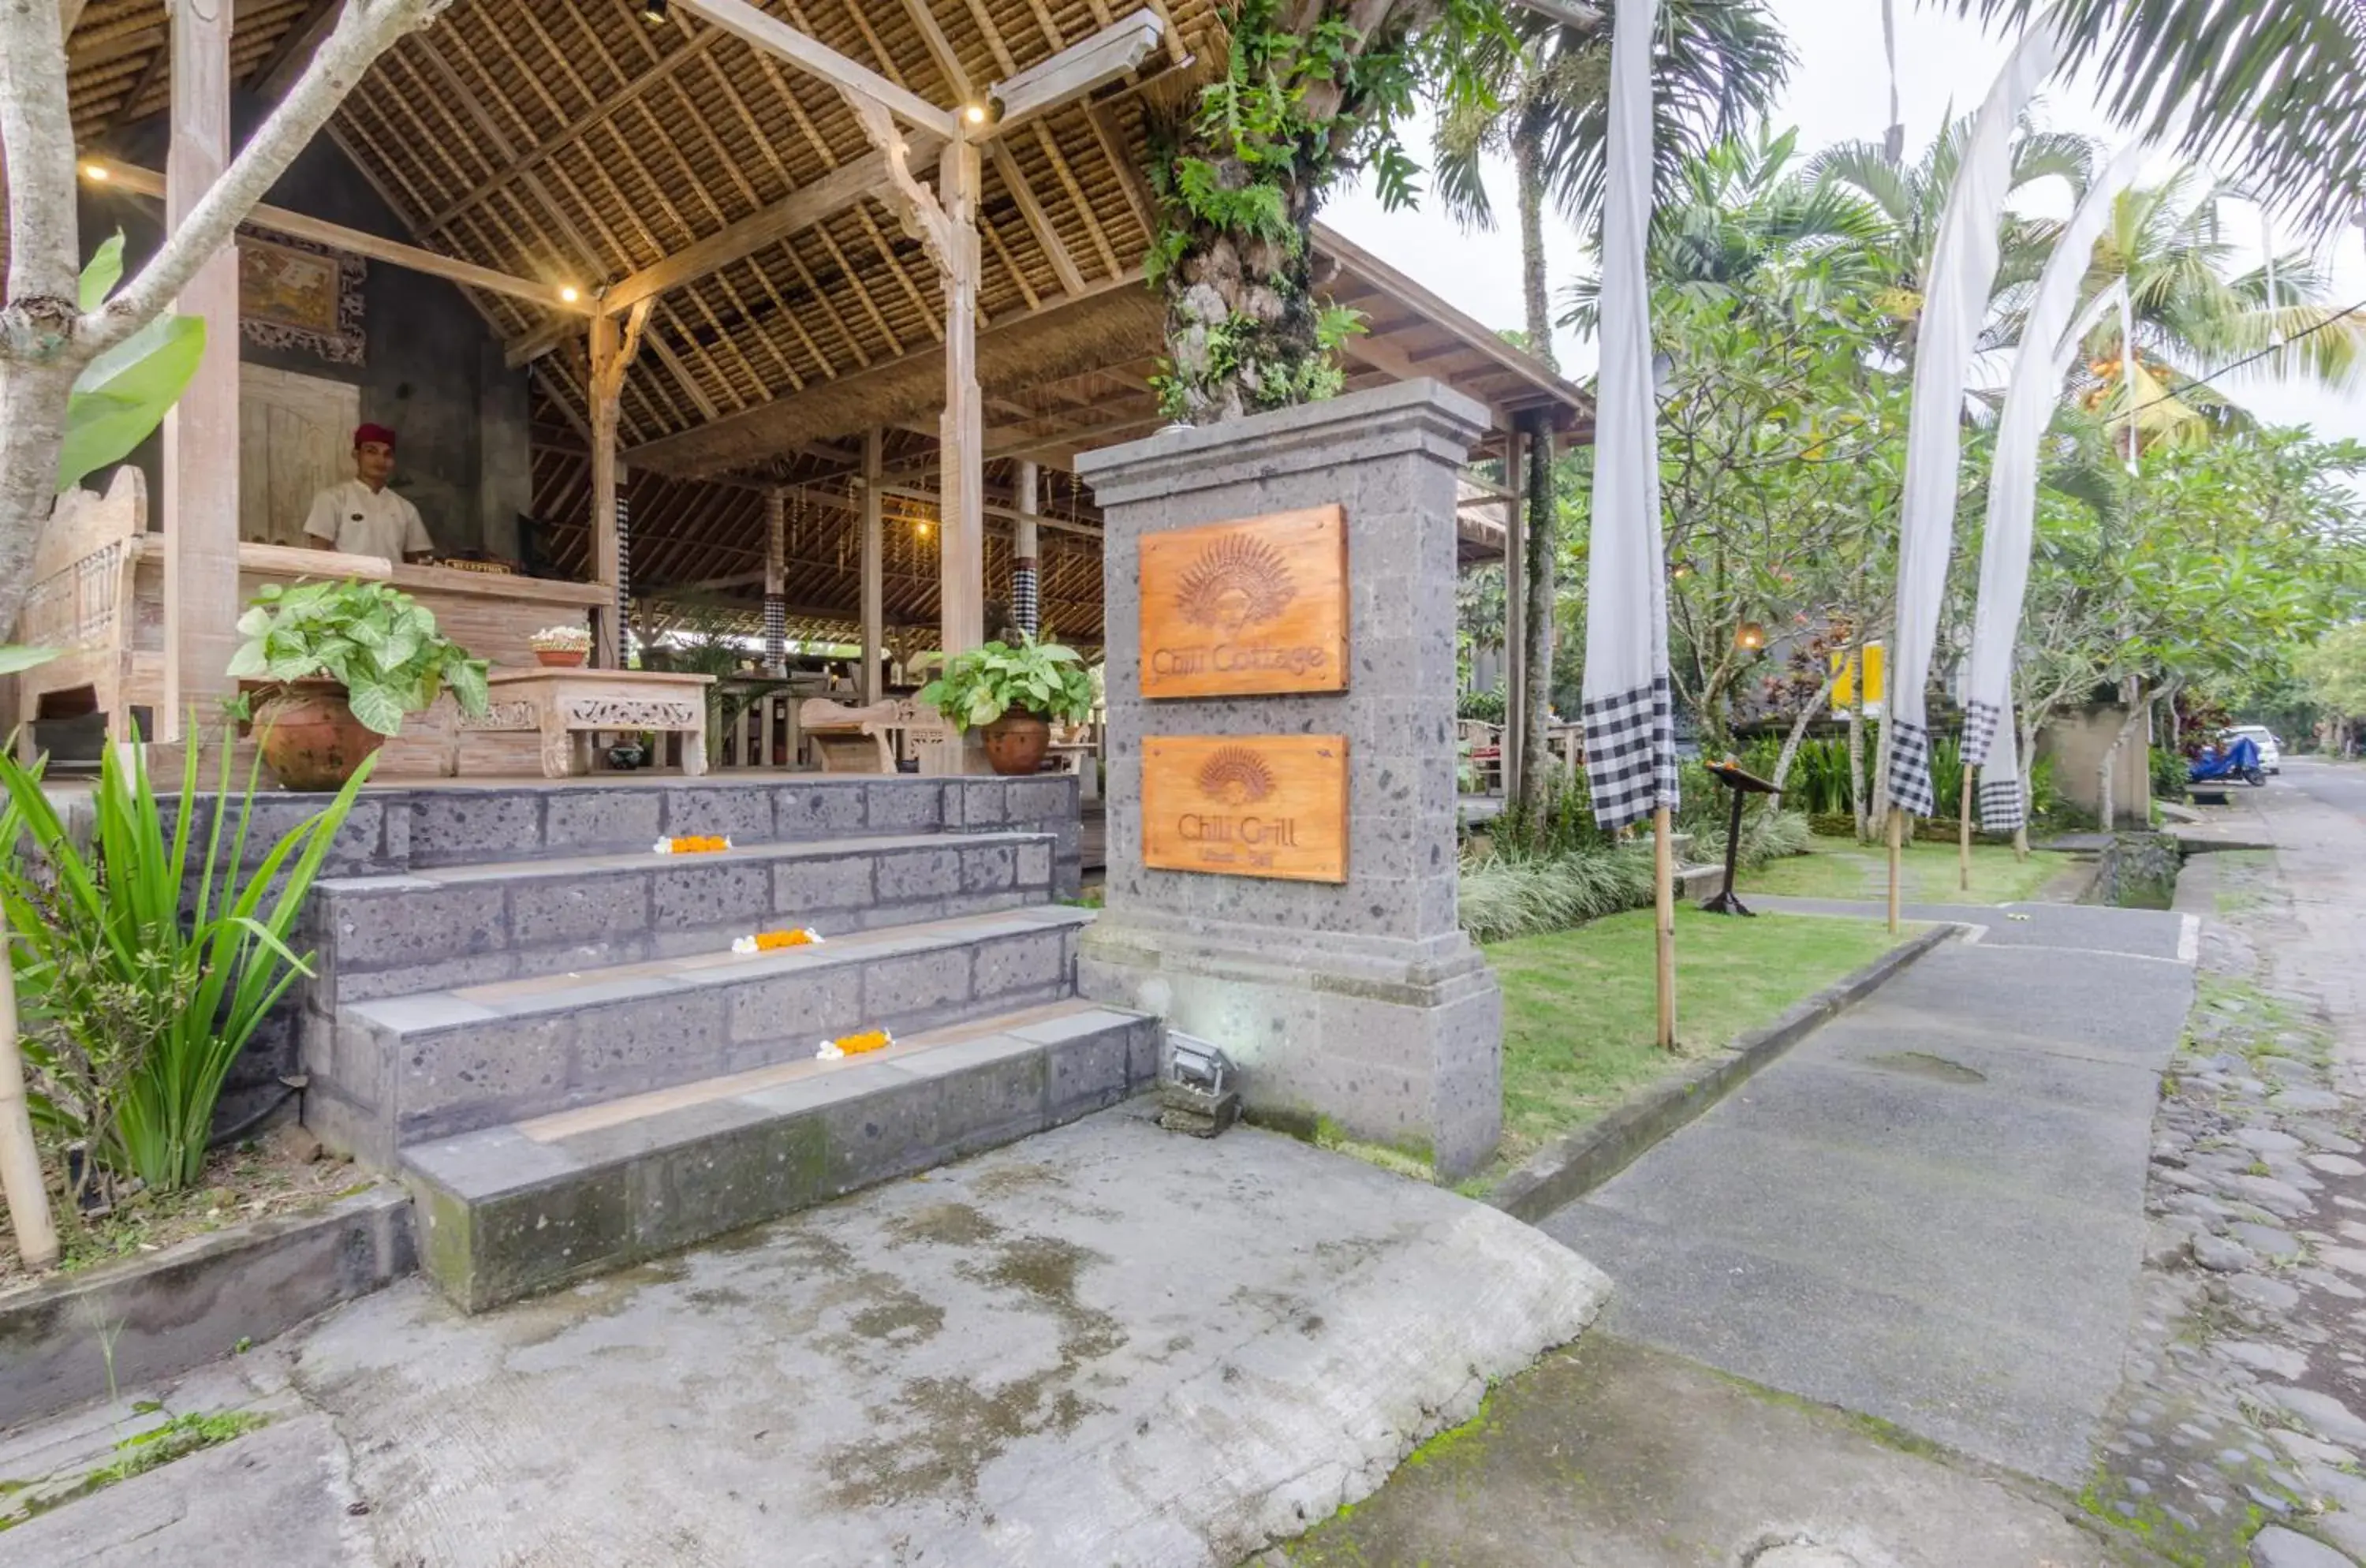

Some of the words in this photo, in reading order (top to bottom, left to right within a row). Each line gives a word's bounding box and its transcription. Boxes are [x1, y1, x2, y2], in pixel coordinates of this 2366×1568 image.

[1213, 642, 1325, 676] Cottage
[1178, 813, 1232, 842] Chilli
[1240, 816, 1298, 846] Grill
